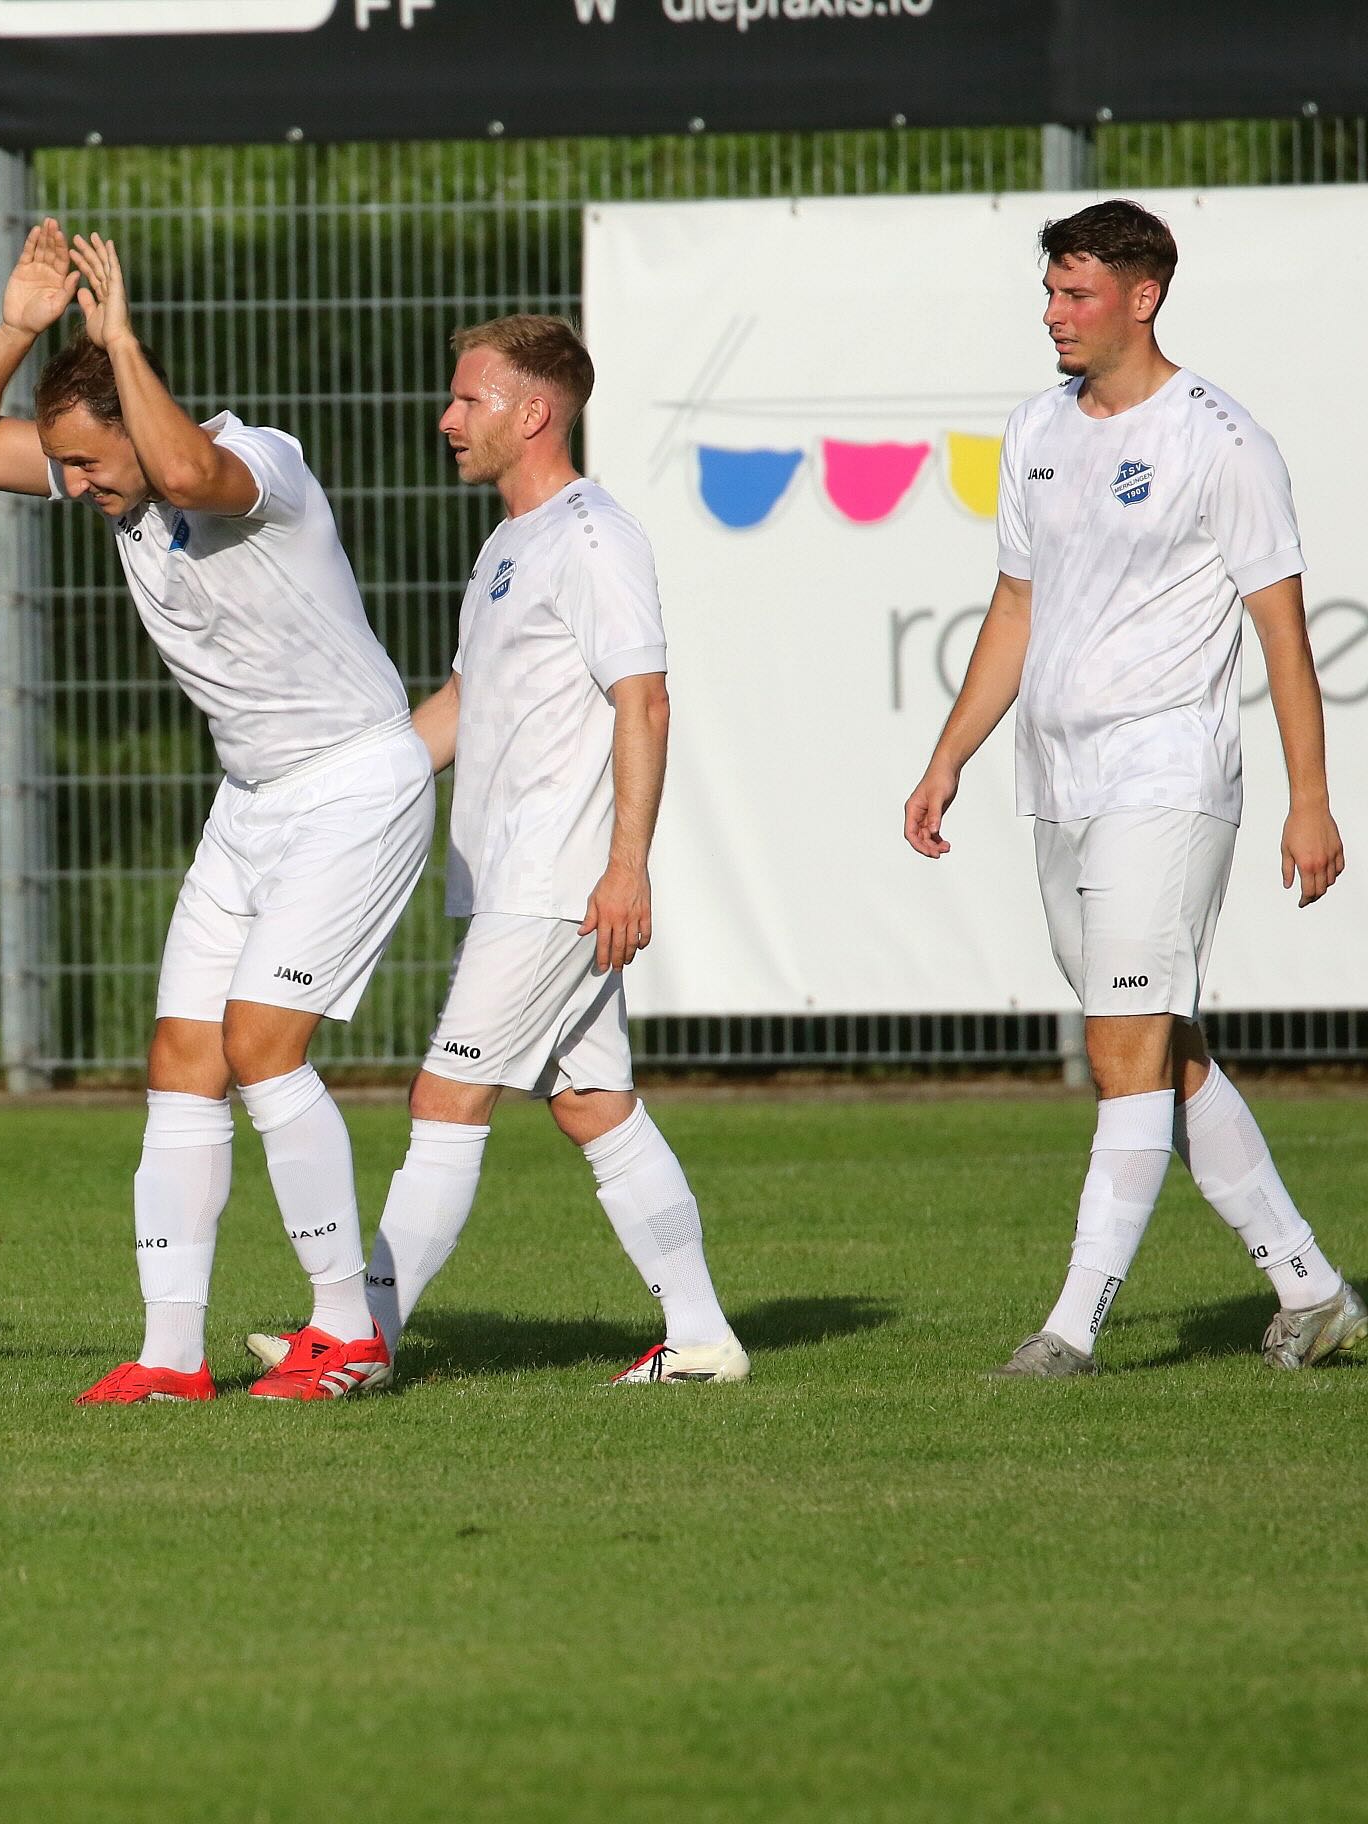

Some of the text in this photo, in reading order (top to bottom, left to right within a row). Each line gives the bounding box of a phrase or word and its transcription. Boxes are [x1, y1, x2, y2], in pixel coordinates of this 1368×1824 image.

[1027, 467, 1054, 481] JAKO
[1120, 462, 1142, 479] TSV
[1126, 486, 1146, 499] 1901
[273, 965, 314, 986] JAKO
[1112, 975, 1150, 989] JAKO
[443, 1040, 482, 1060] JAKO
[290, 1222, 338, 1239] JAKO
[135, 1237, 169, 1250] AKO
